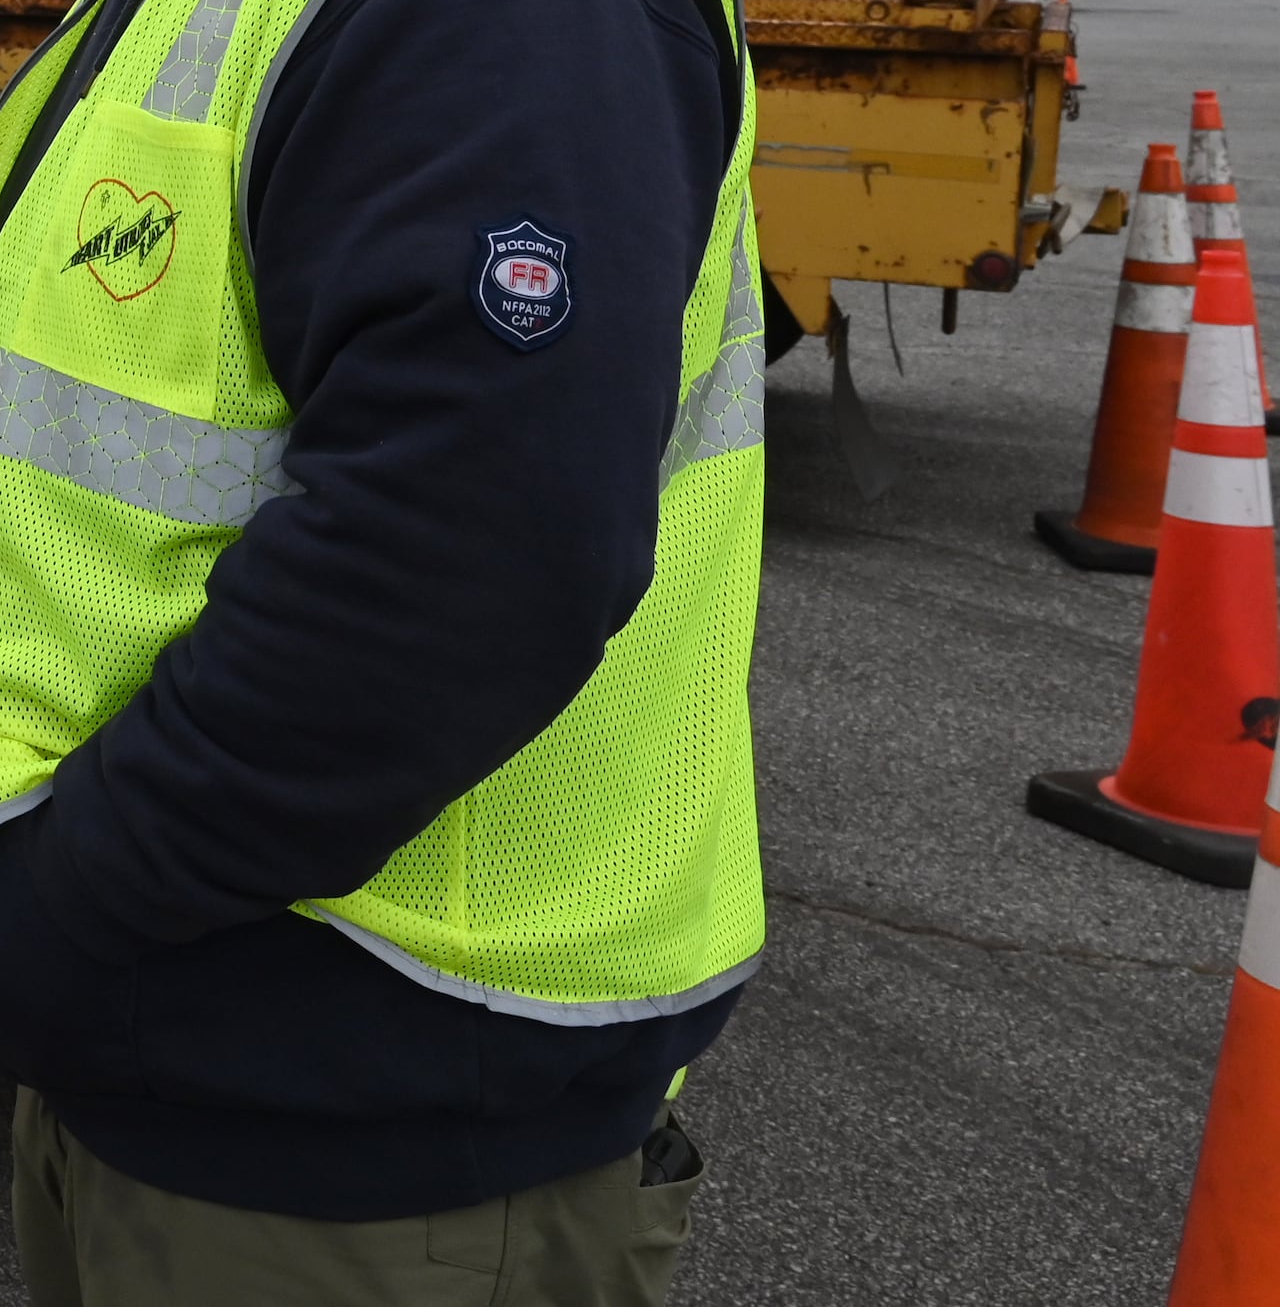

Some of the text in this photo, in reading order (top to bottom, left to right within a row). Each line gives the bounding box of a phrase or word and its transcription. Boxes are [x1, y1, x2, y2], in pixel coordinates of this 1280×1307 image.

[496, 240, 560, 262] BOCOMAL
[509, 261, 550, 294] FR
[502, 300, 551, 318] NFPA2112
